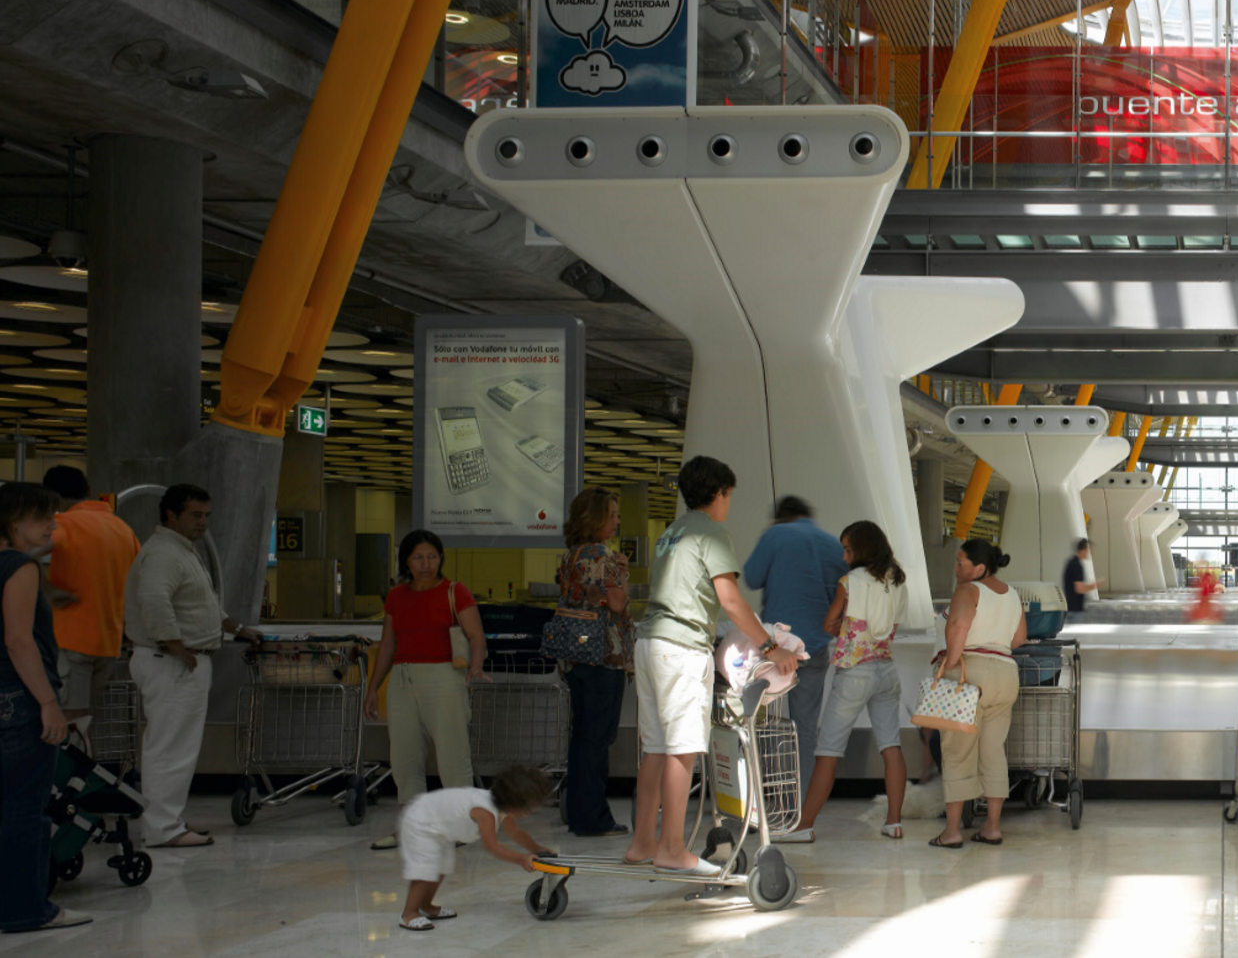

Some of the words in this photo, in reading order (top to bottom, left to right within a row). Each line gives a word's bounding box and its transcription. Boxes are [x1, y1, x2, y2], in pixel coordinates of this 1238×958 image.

[613, 0, 670, 8] AMSTERDAM
[613, 9, 645, 18] LISBOA
[613, 17, 644, 28] MILÁN.
[1079, 92, 1218, 116] puente
[434, 344, 452, 353] Sólo
[470, 345, 507, 353] Vodafone
[509, 345, 518, 353] tu
[520, 343, 543, 353] móvil
[434, 354, 459, 363] e-mail
[509, 354, 547, 363] velocidad
[548, 354, 560, 363] 3G
[278, 533, 298, 549] 16
